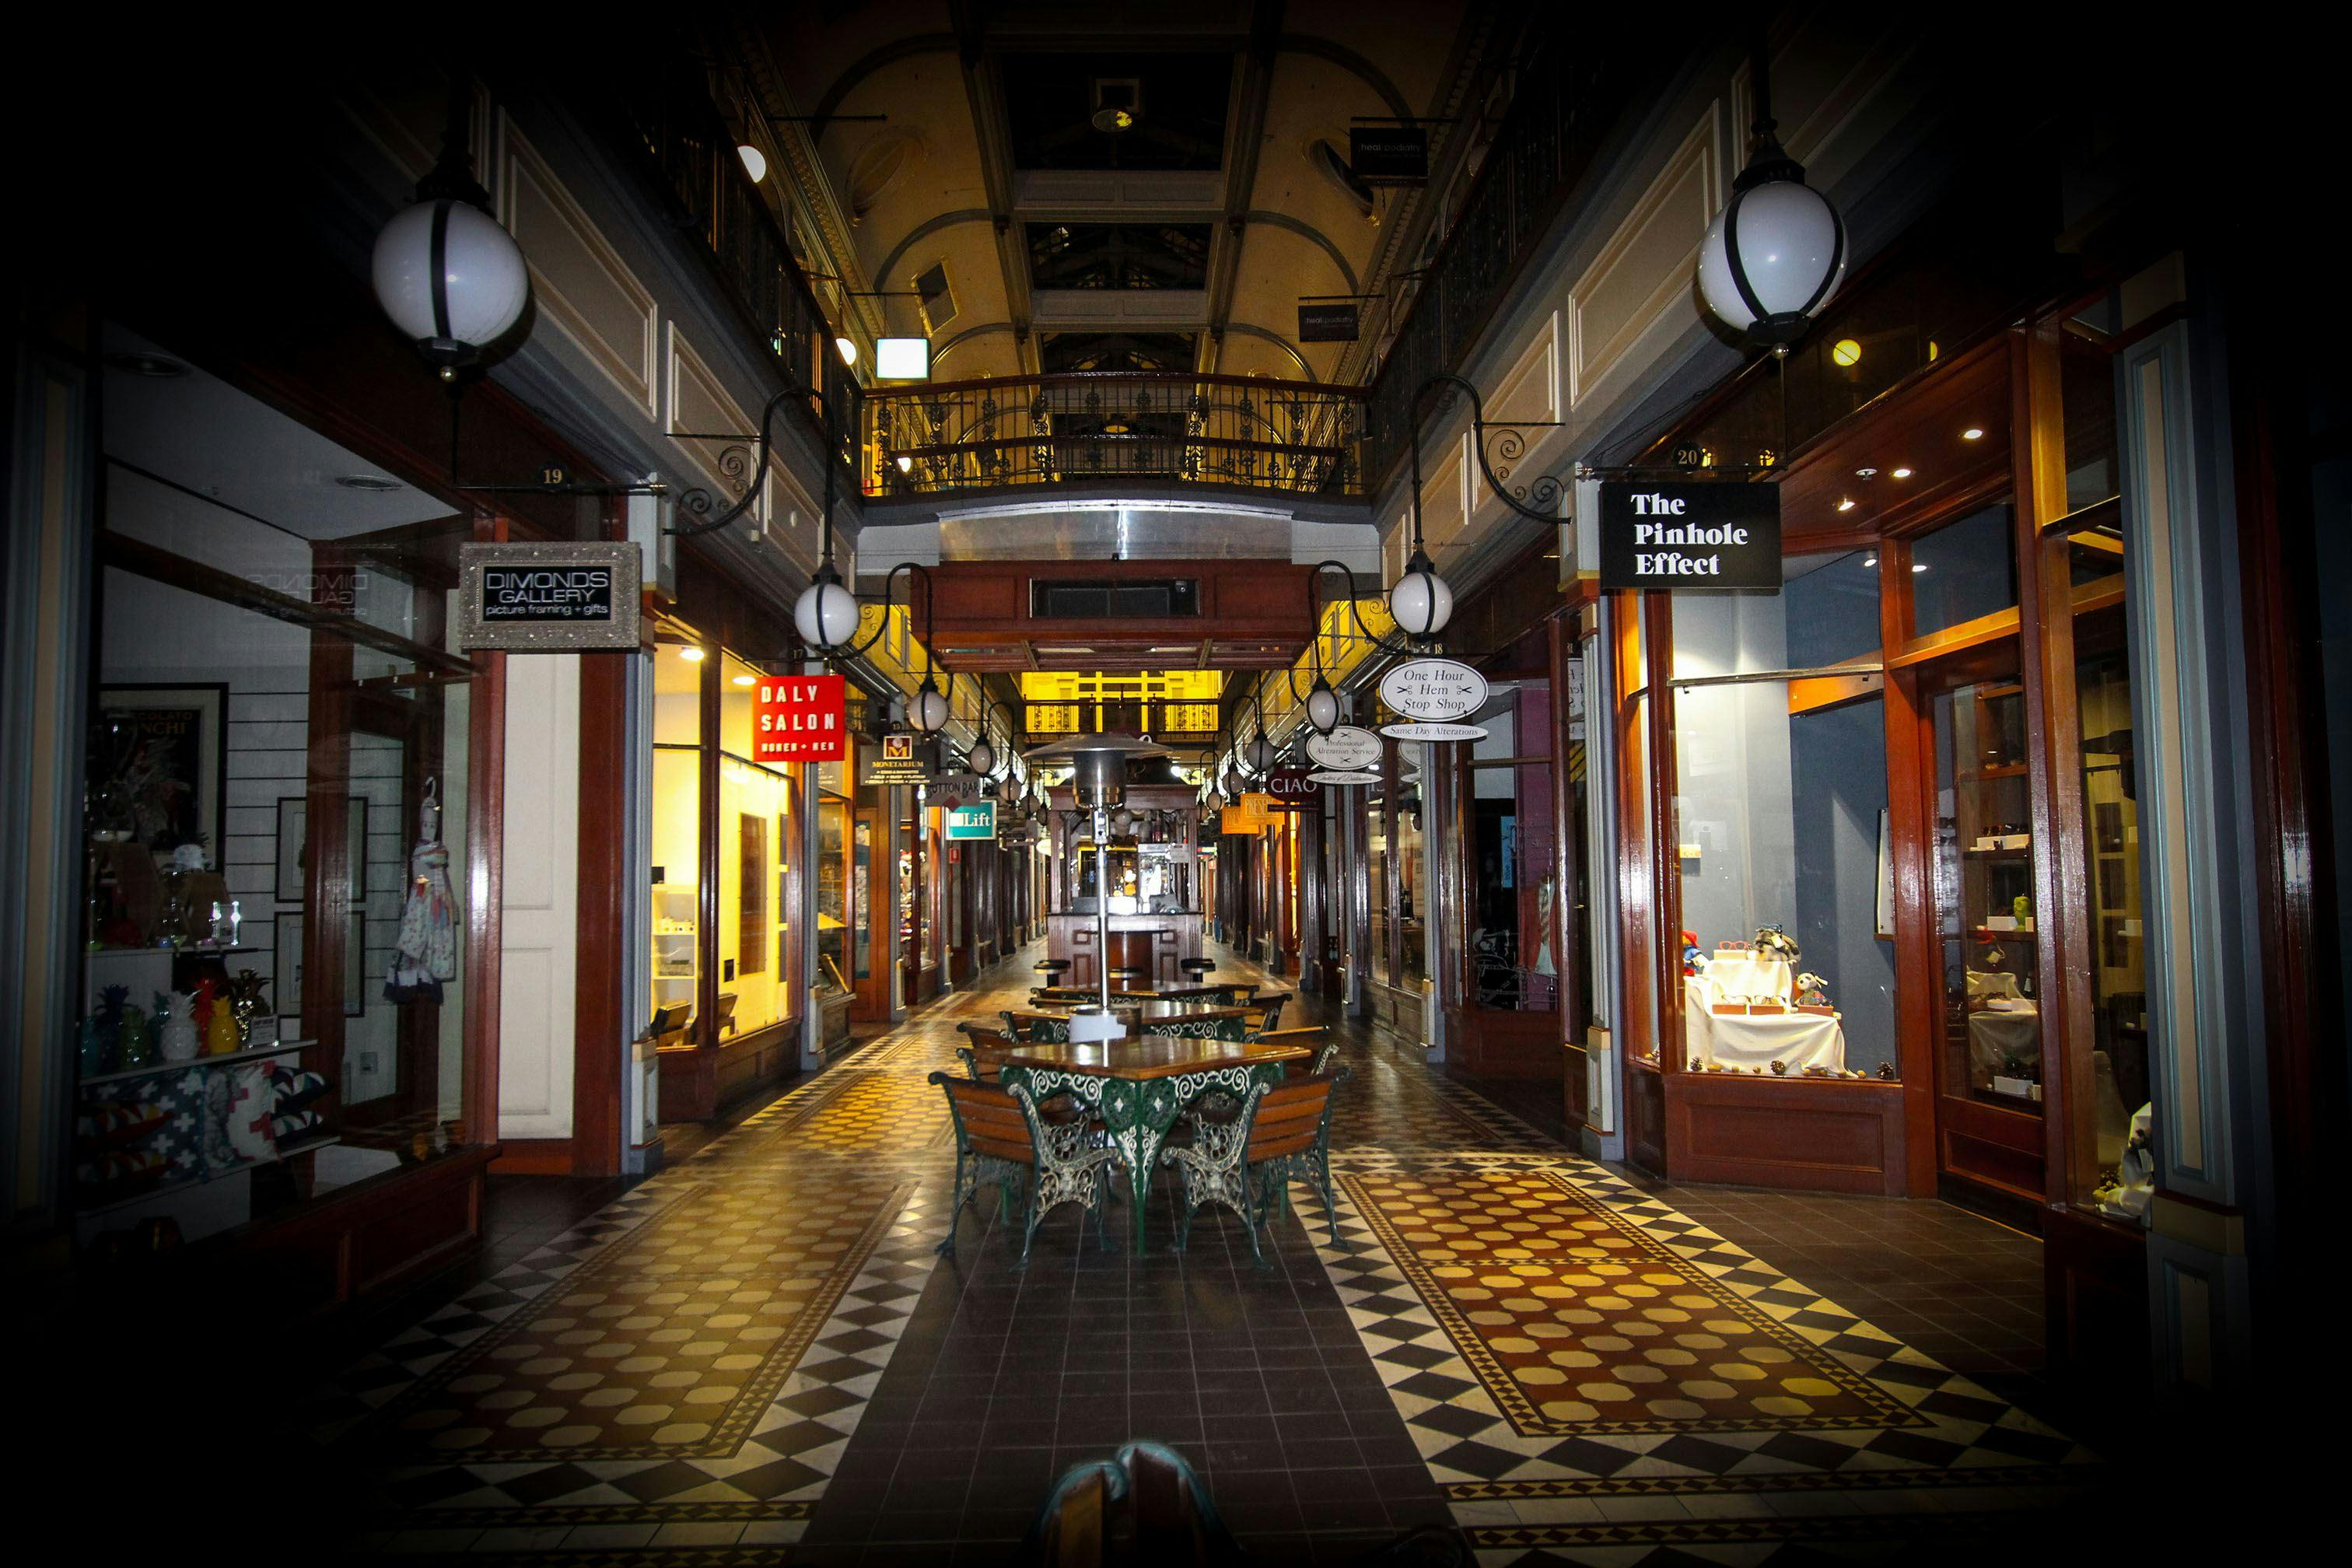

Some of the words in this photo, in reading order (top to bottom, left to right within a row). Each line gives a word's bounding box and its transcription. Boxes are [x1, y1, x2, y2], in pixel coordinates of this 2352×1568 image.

[1677, 449, 1698, 465] 20
[543, 468, 563, 485] 19
[1630, 492, 1686, 516] The
[1634, 522, 1748, 545] Pinhole
[1635, 551, 1720, 576] Effect
[485, 572, 609, 590] DIMONDS
[499, 589, 596, 604] GALLERY
[485, 604, 526, 617] picture
[527, 604, 572, 616] framing
[583, 603, 608, 616] gifts
[793, 649, 804, 659] 17
[1434, 643, 1444, 654] 18
[1404, 670, 1429, 681] One
[1434, 670, 1465, 681] Hour
[761, 685, 817, 703] DALY
[1420, 684, 1448, 695] Hem
[1403, 698, 1430, 712] Stop
[1436, 698, 1465, 712] Shop
[761, 713, 835, 732] SALON
[1390, 726, 1412, 735] Same
[1416, 726, 1431, 737] Day
[1433, 726, 1479, 736] Alterations
[887, 746, 908, 758] M
[926, 782, 961, 799] BUTTON
[962, 782, 980, 799] BAR
[1270, 778, 1318, 793] CIAO
[964, 812, 991, 827] Lift
